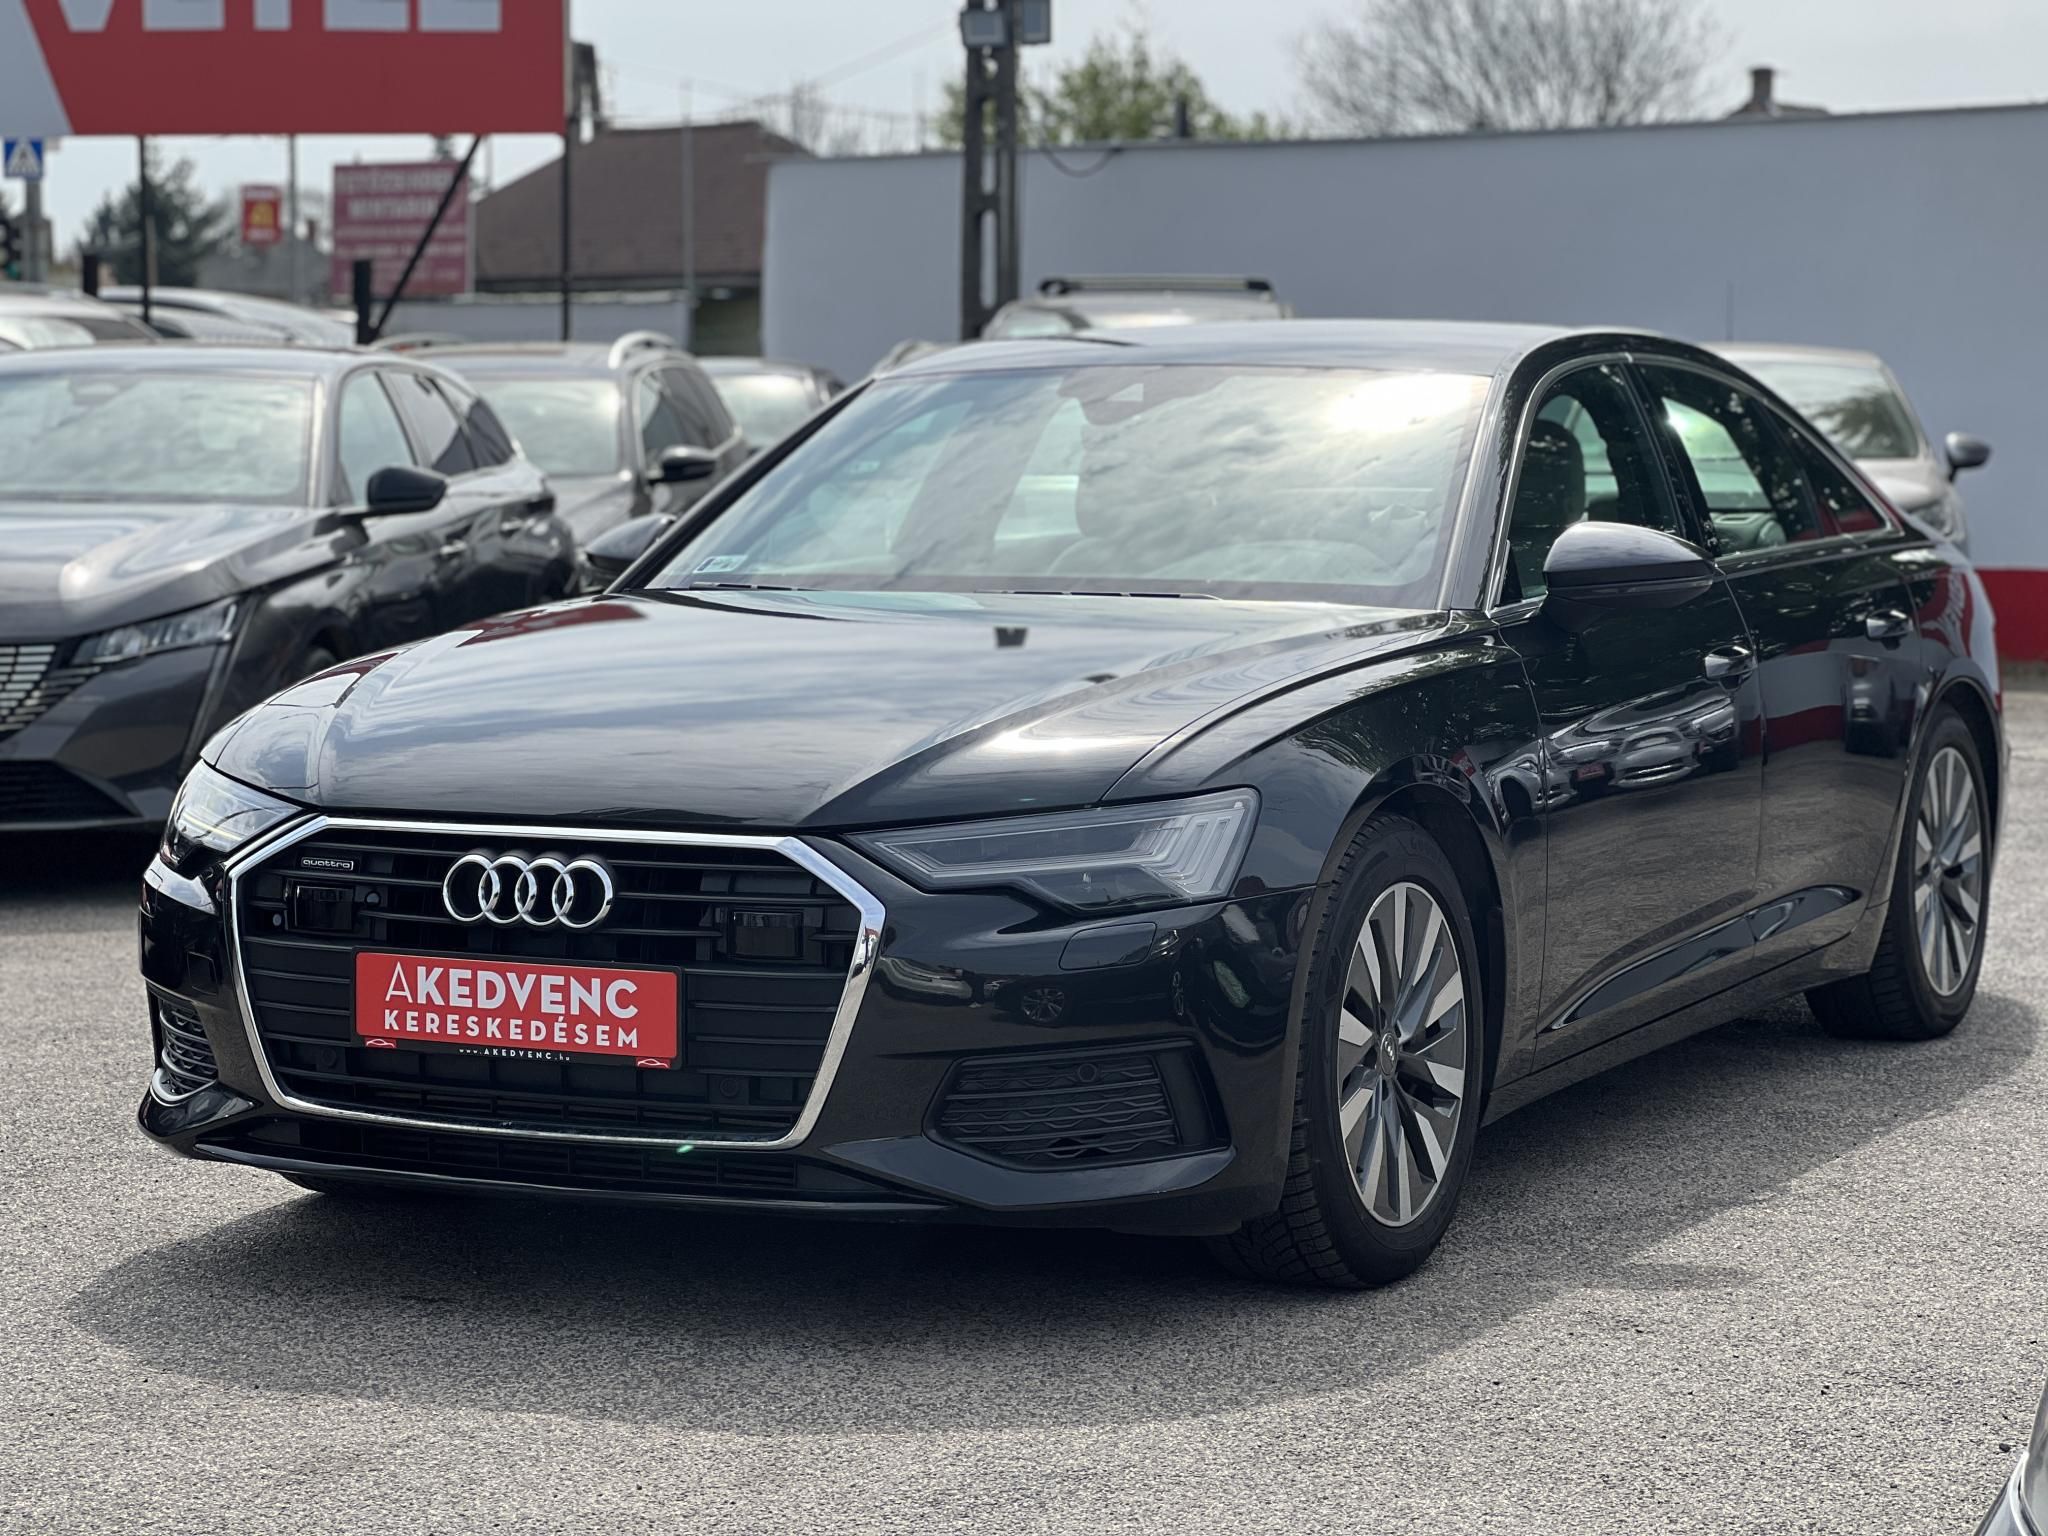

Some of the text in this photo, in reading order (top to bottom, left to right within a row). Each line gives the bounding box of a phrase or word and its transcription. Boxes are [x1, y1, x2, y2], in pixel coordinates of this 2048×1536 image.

[302, 859, 352, 870] quattro
[385, 961, 639, 1020] AKEDVENC
[384, 1009, 638, 1049] KERESKEDÉSEM
[459, 1048, 570, 1061] www.AKEDVENC.hu
